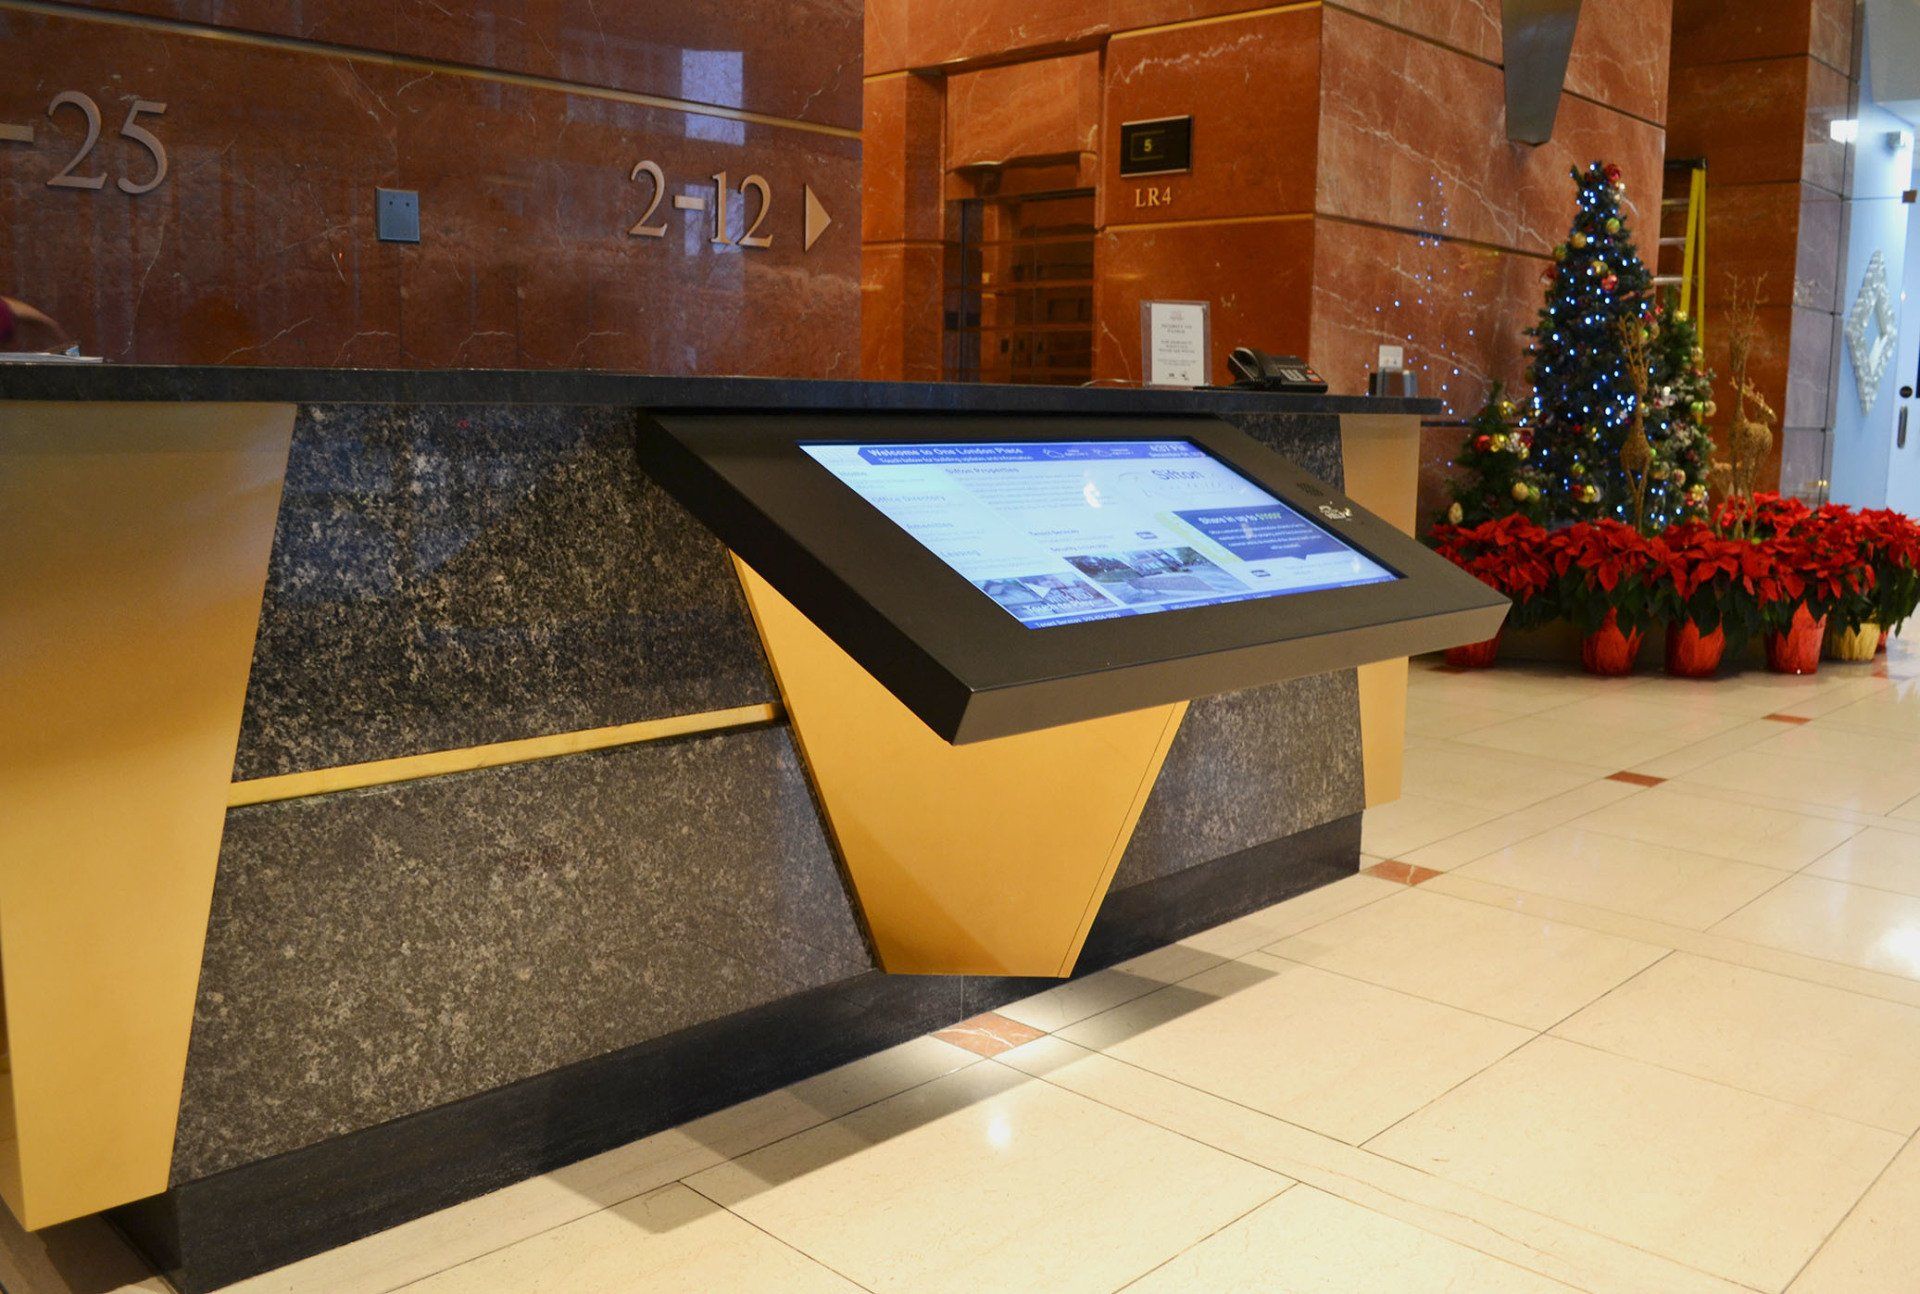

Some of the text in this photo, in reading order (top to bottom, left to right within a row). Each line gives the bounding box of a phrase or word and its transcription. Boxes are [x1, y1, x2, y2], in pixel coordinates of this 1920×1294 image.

[1143, 138, 1153, 152] 5
[629, 160, 773, 248] 2-12
[1135, 186, 1172, 208] LR4
[866, 448, 921, 457] Welcome
[954, 447, 996, 455] London
[1150, 468, 1204, 480] Sifton
